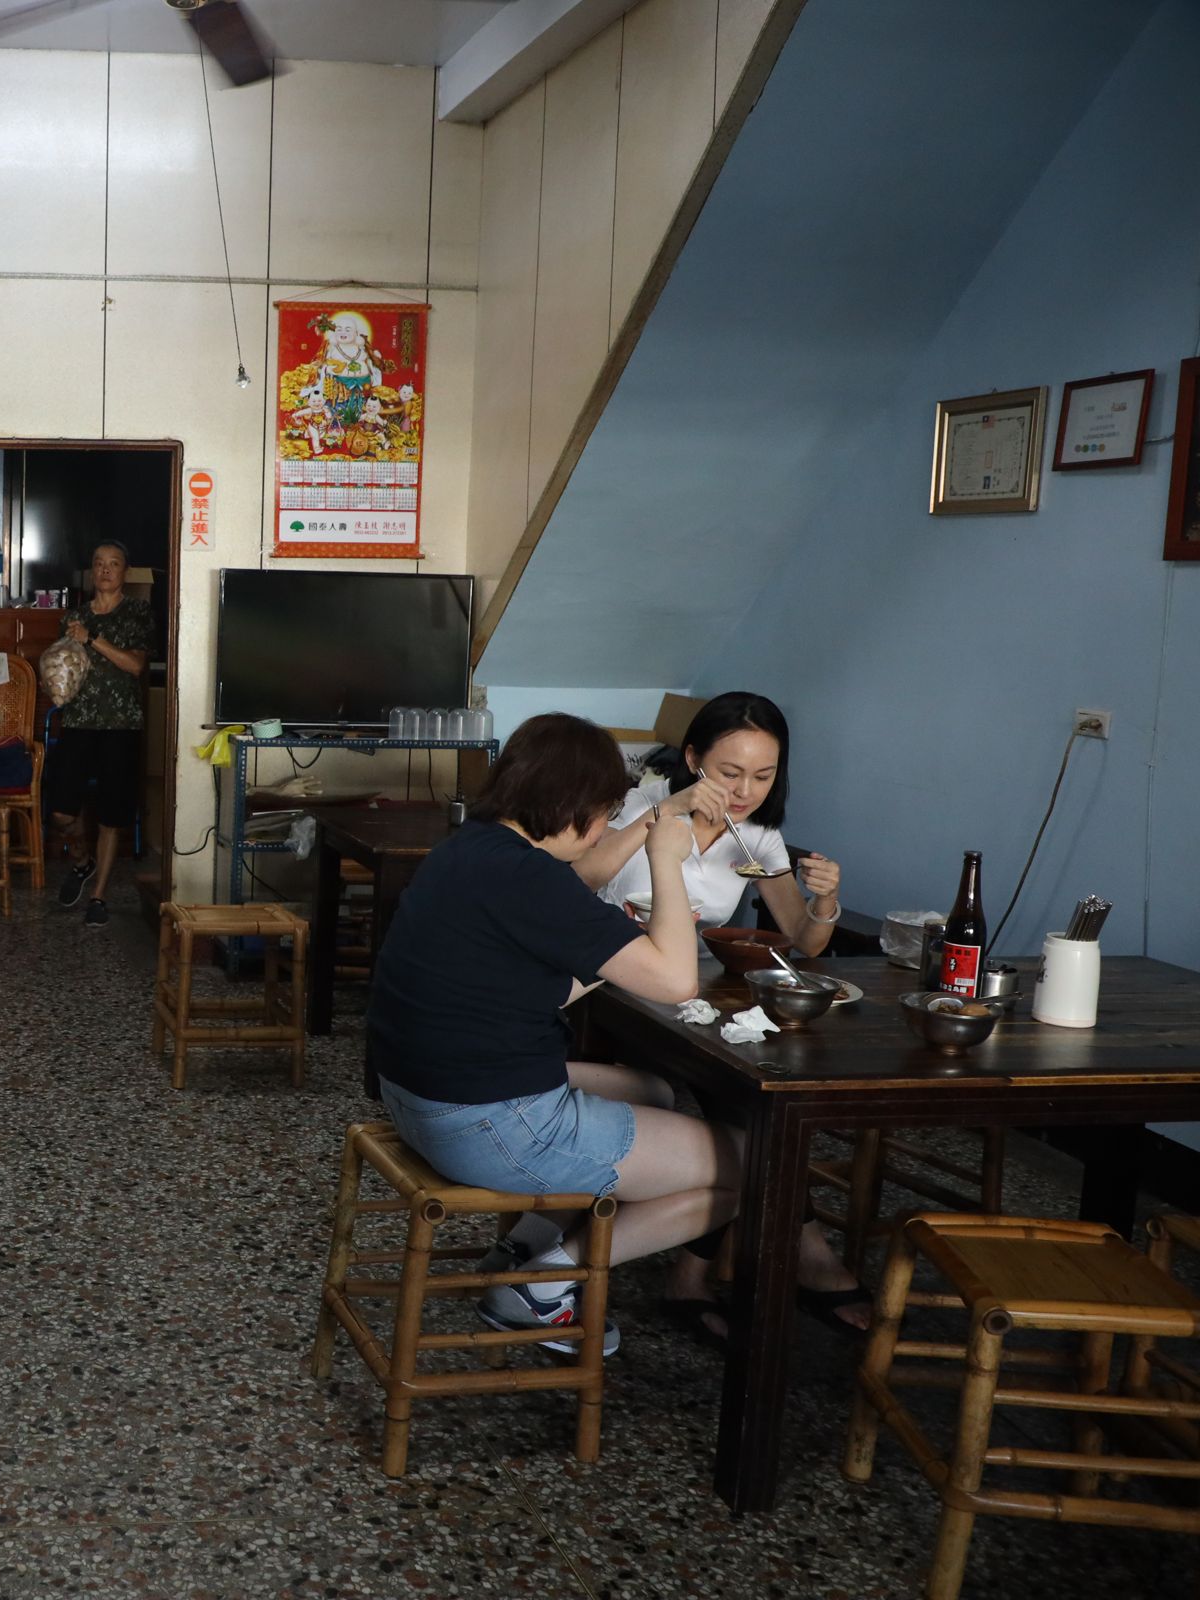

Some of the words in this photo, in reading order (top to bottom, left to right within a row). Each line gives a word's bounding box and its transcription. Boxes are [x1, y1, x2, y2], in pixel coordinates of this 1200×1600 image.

[191, 498, 209, 546] 禁止進入
[308, 522, 347, 531] 國泰人壽
